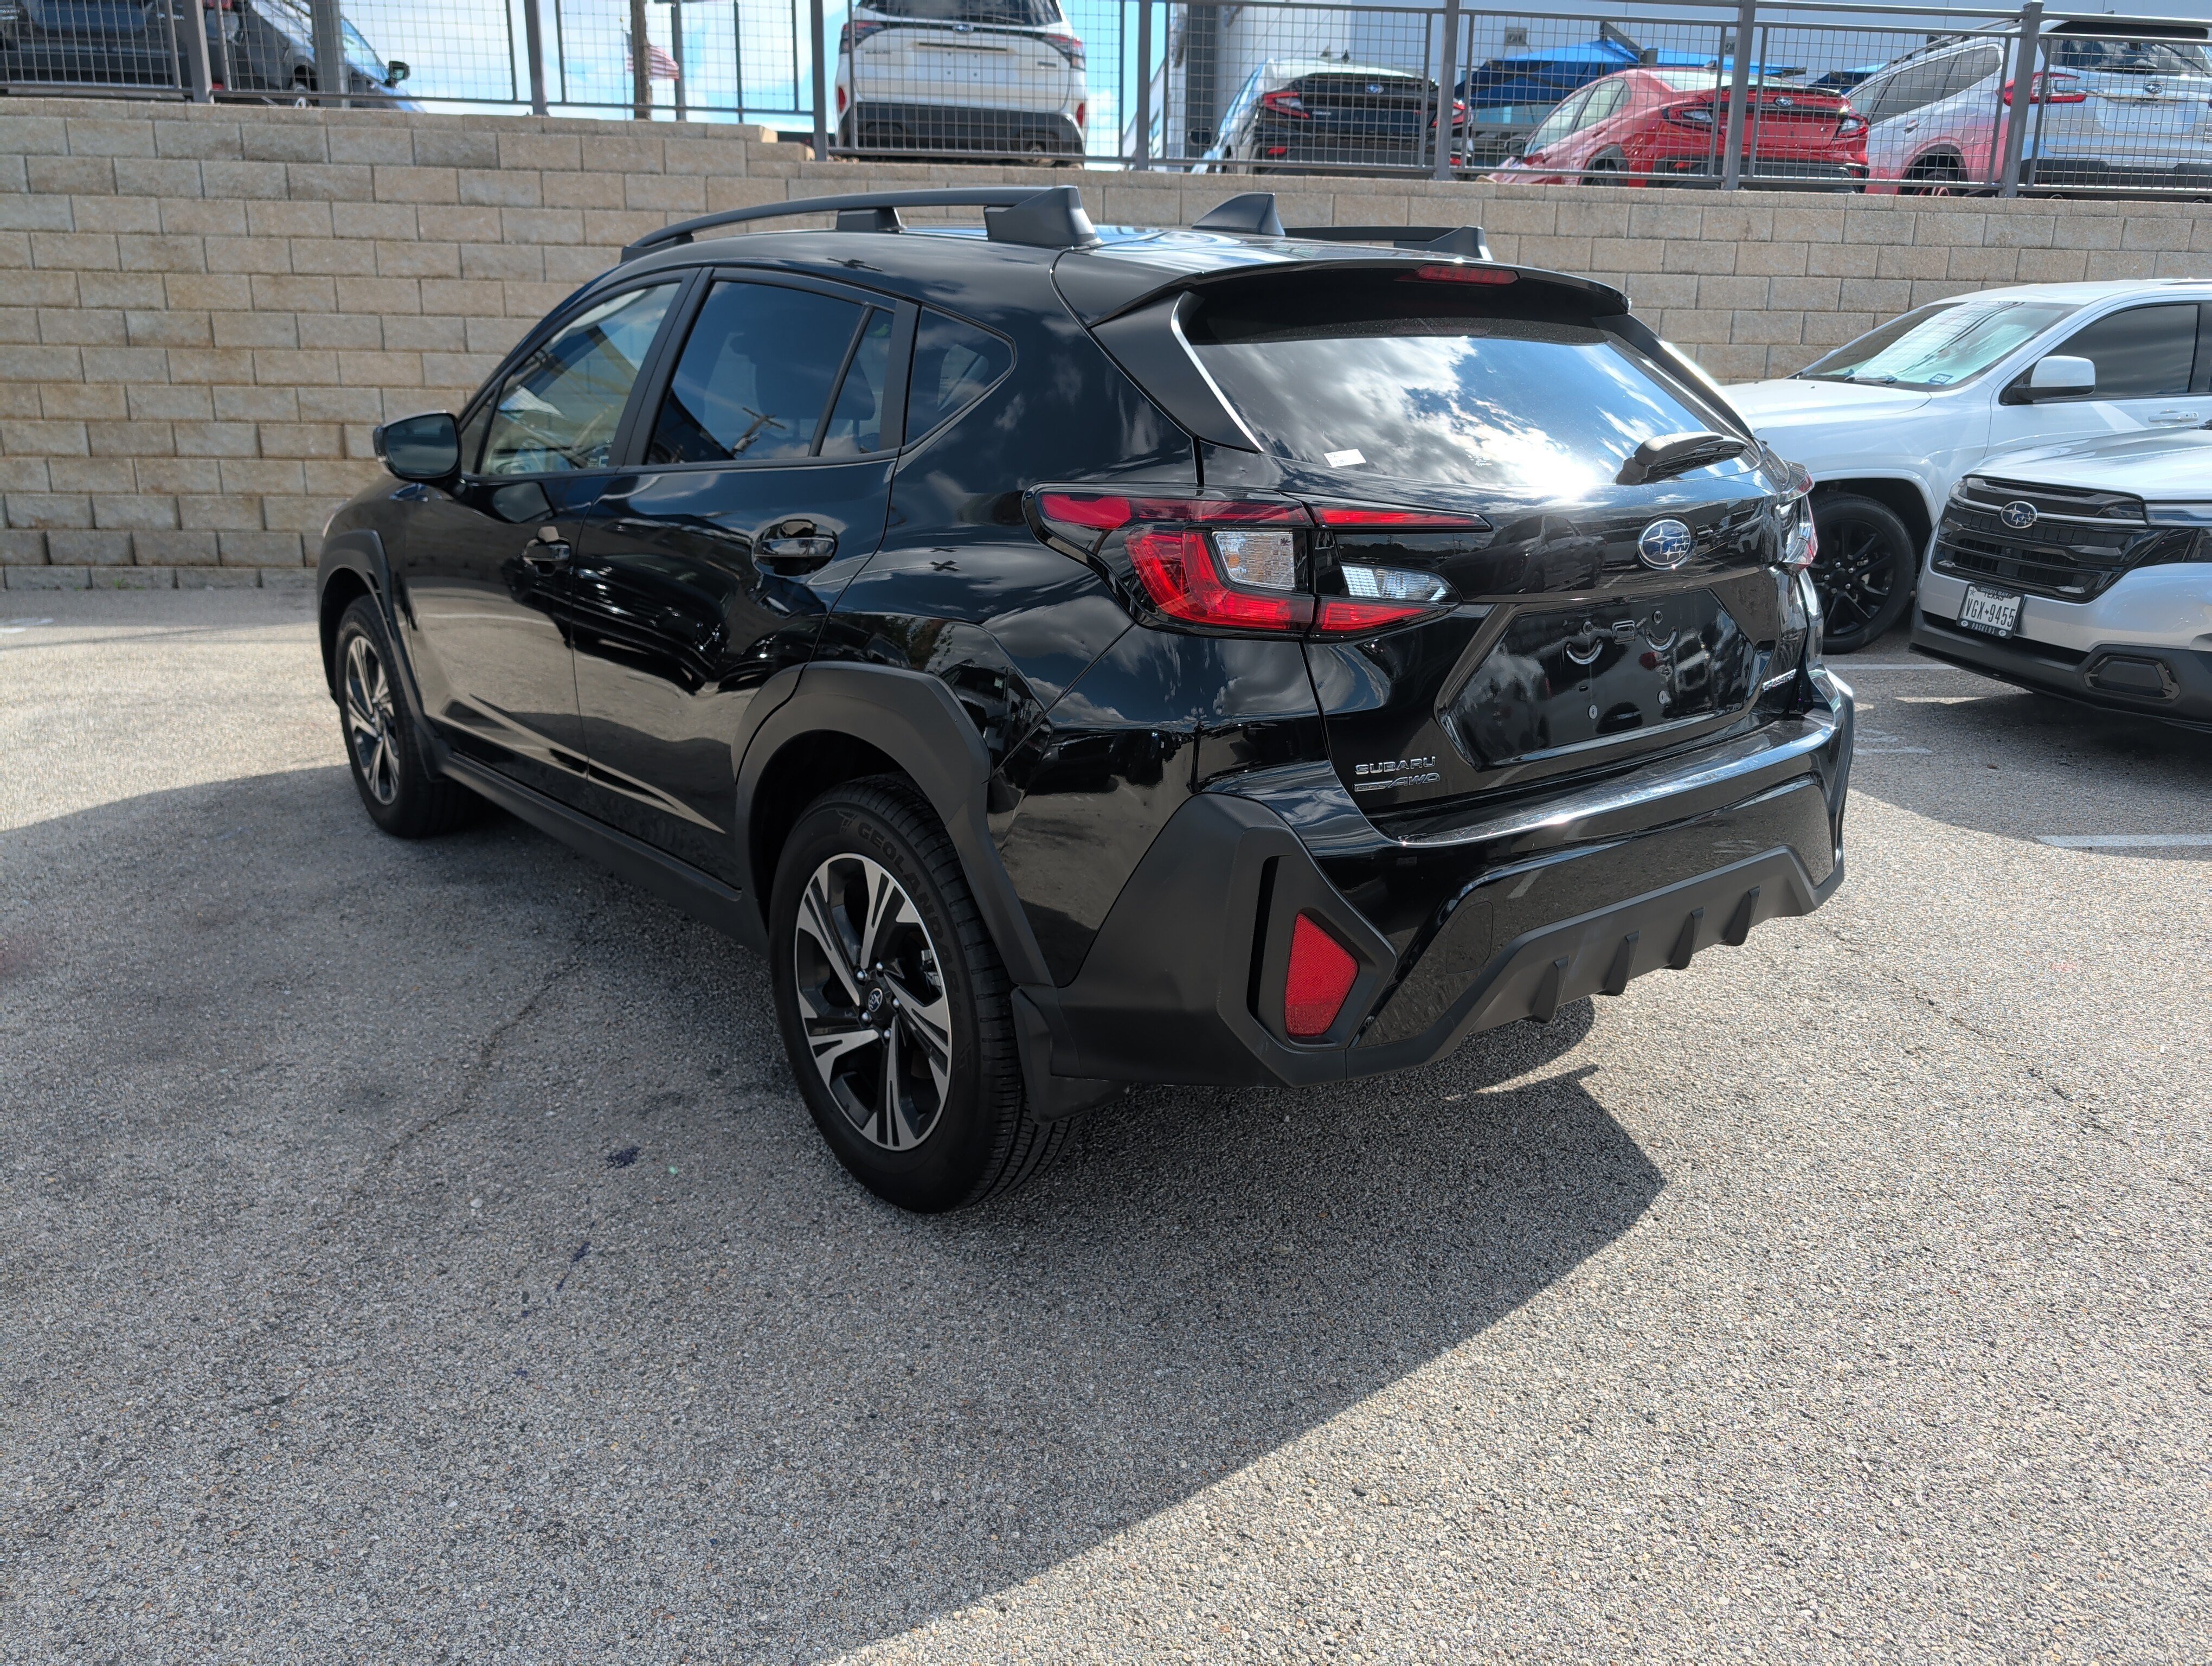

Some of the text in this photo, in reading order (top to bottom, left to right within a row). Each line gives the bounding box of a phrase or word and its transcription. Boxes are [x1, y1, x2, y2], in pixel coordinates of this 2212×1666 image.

[1965, 598, 2016, 627] VGX 9455
[1971, 623, 1995, 634] PACKERS
[1355, 756, 1436, 775] SUBARU
[1388, 772, 1441, 789] AWD
[857, 821, 960, 994] GEOLANDAR
